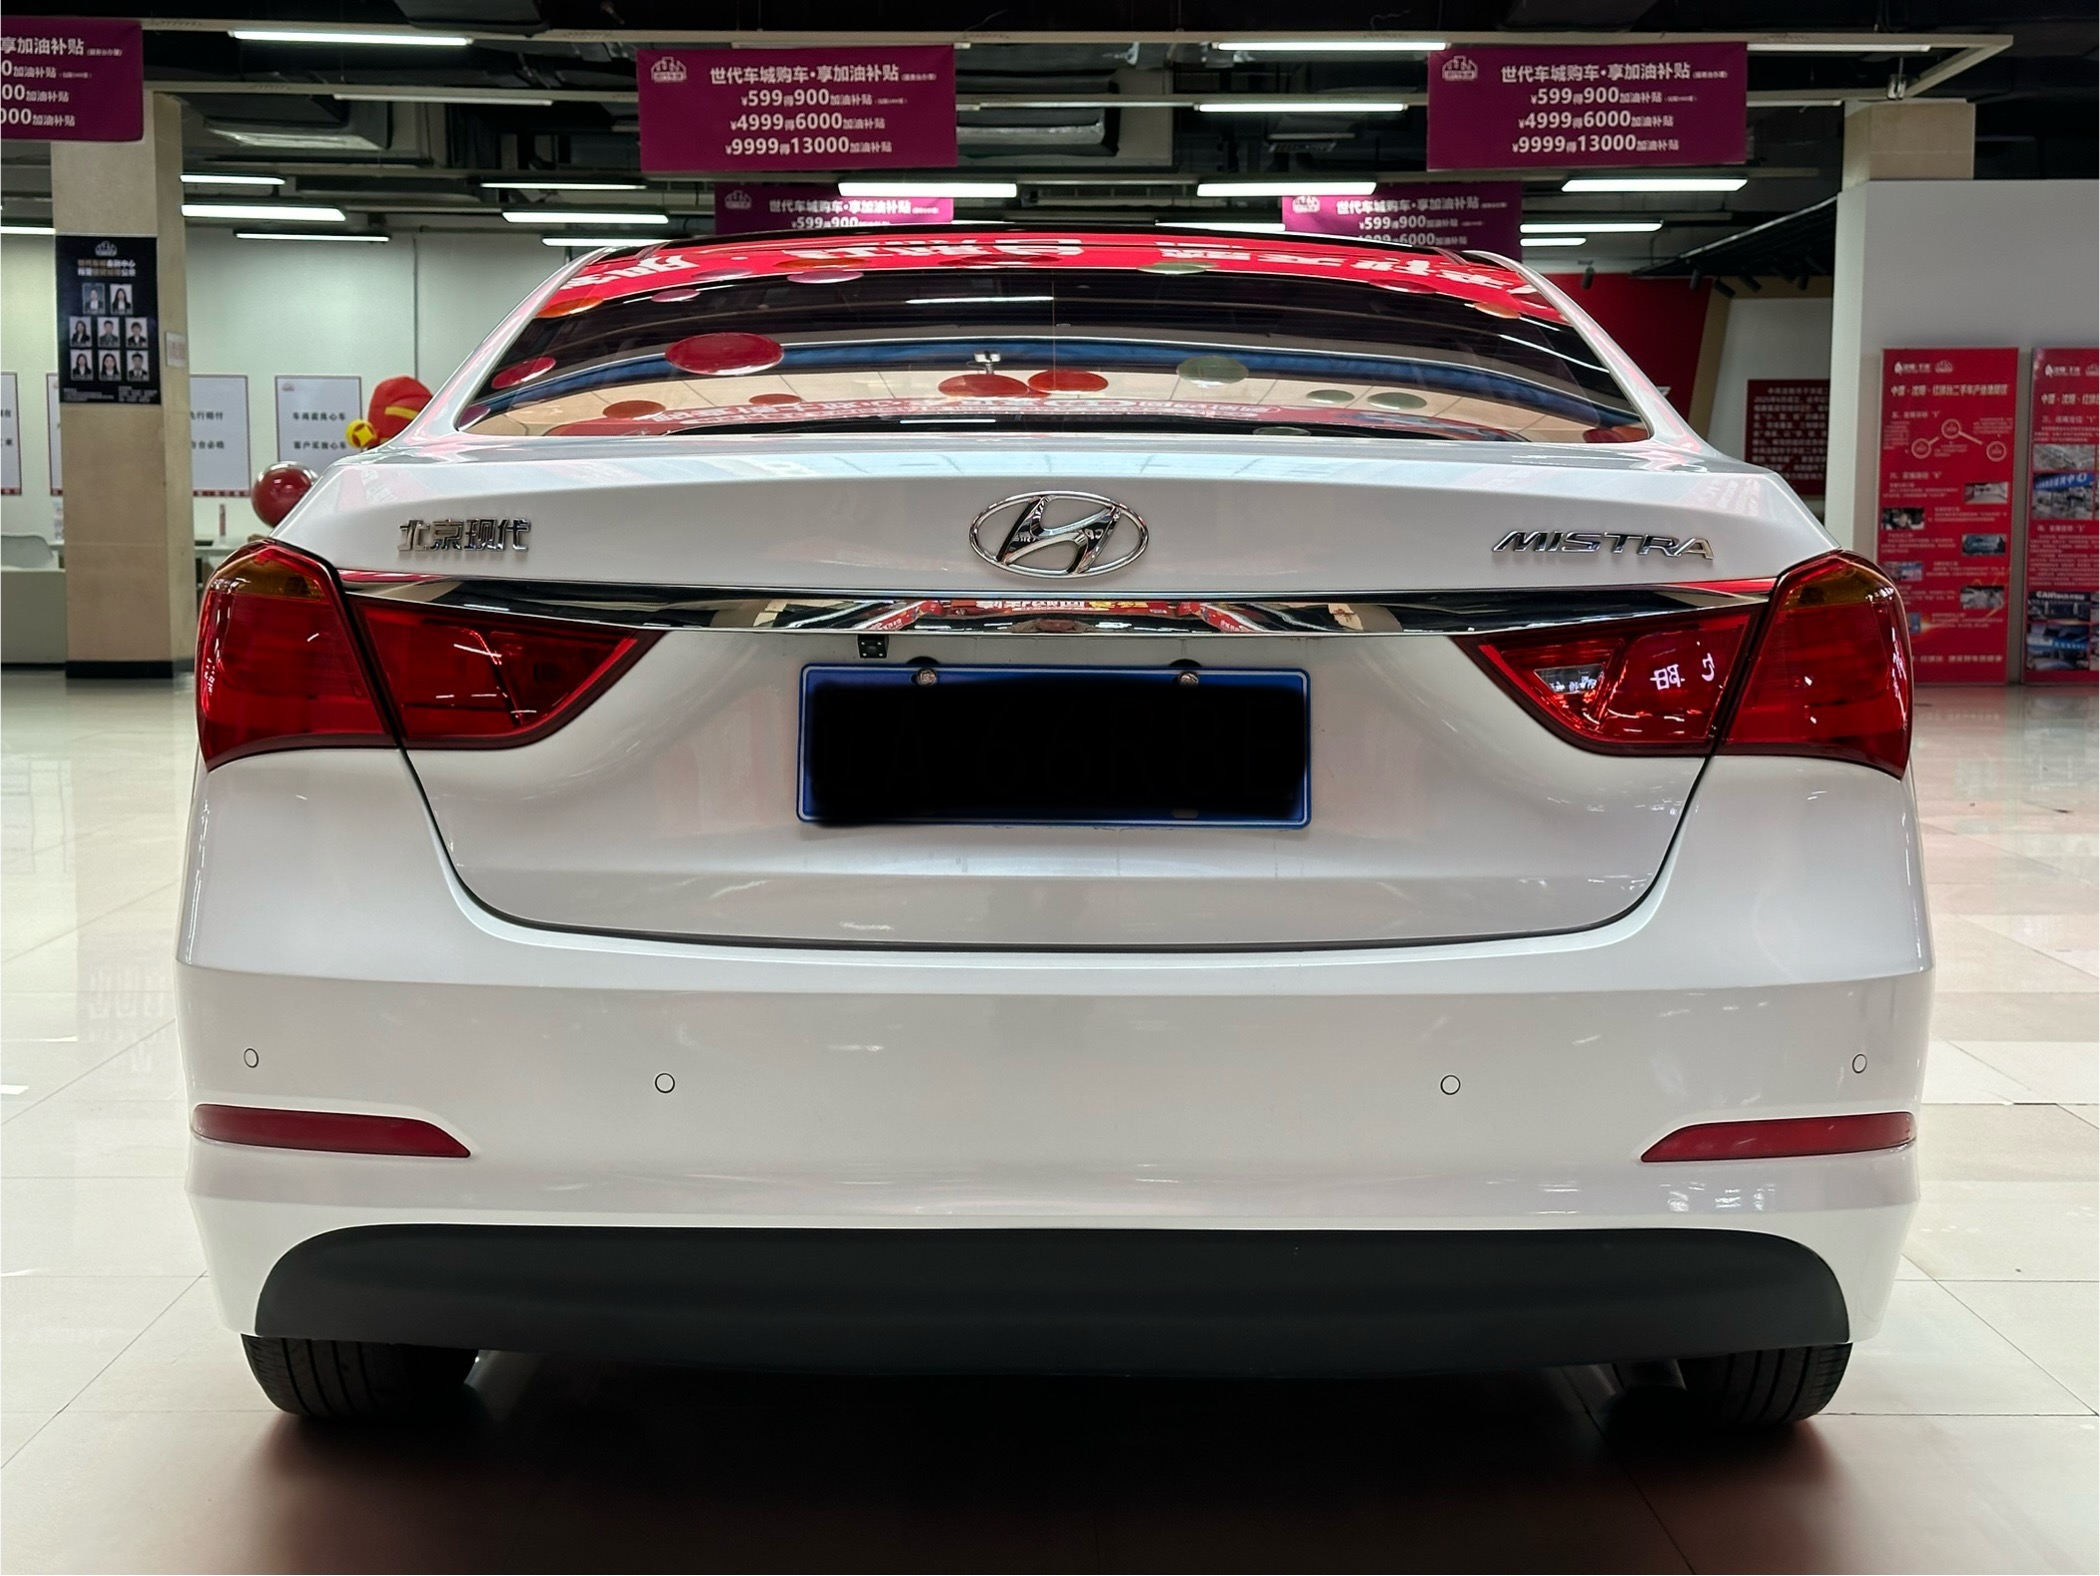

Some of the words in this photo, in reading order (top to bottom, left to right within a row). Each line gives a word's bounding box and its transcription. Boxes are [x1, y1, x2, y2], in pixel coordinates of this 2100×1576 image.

[1, 37, 84, 55] 享加油补贴
[398, 518, 531, 552] 北京现代
[1491, 530, 1714, 560] MISTRA
